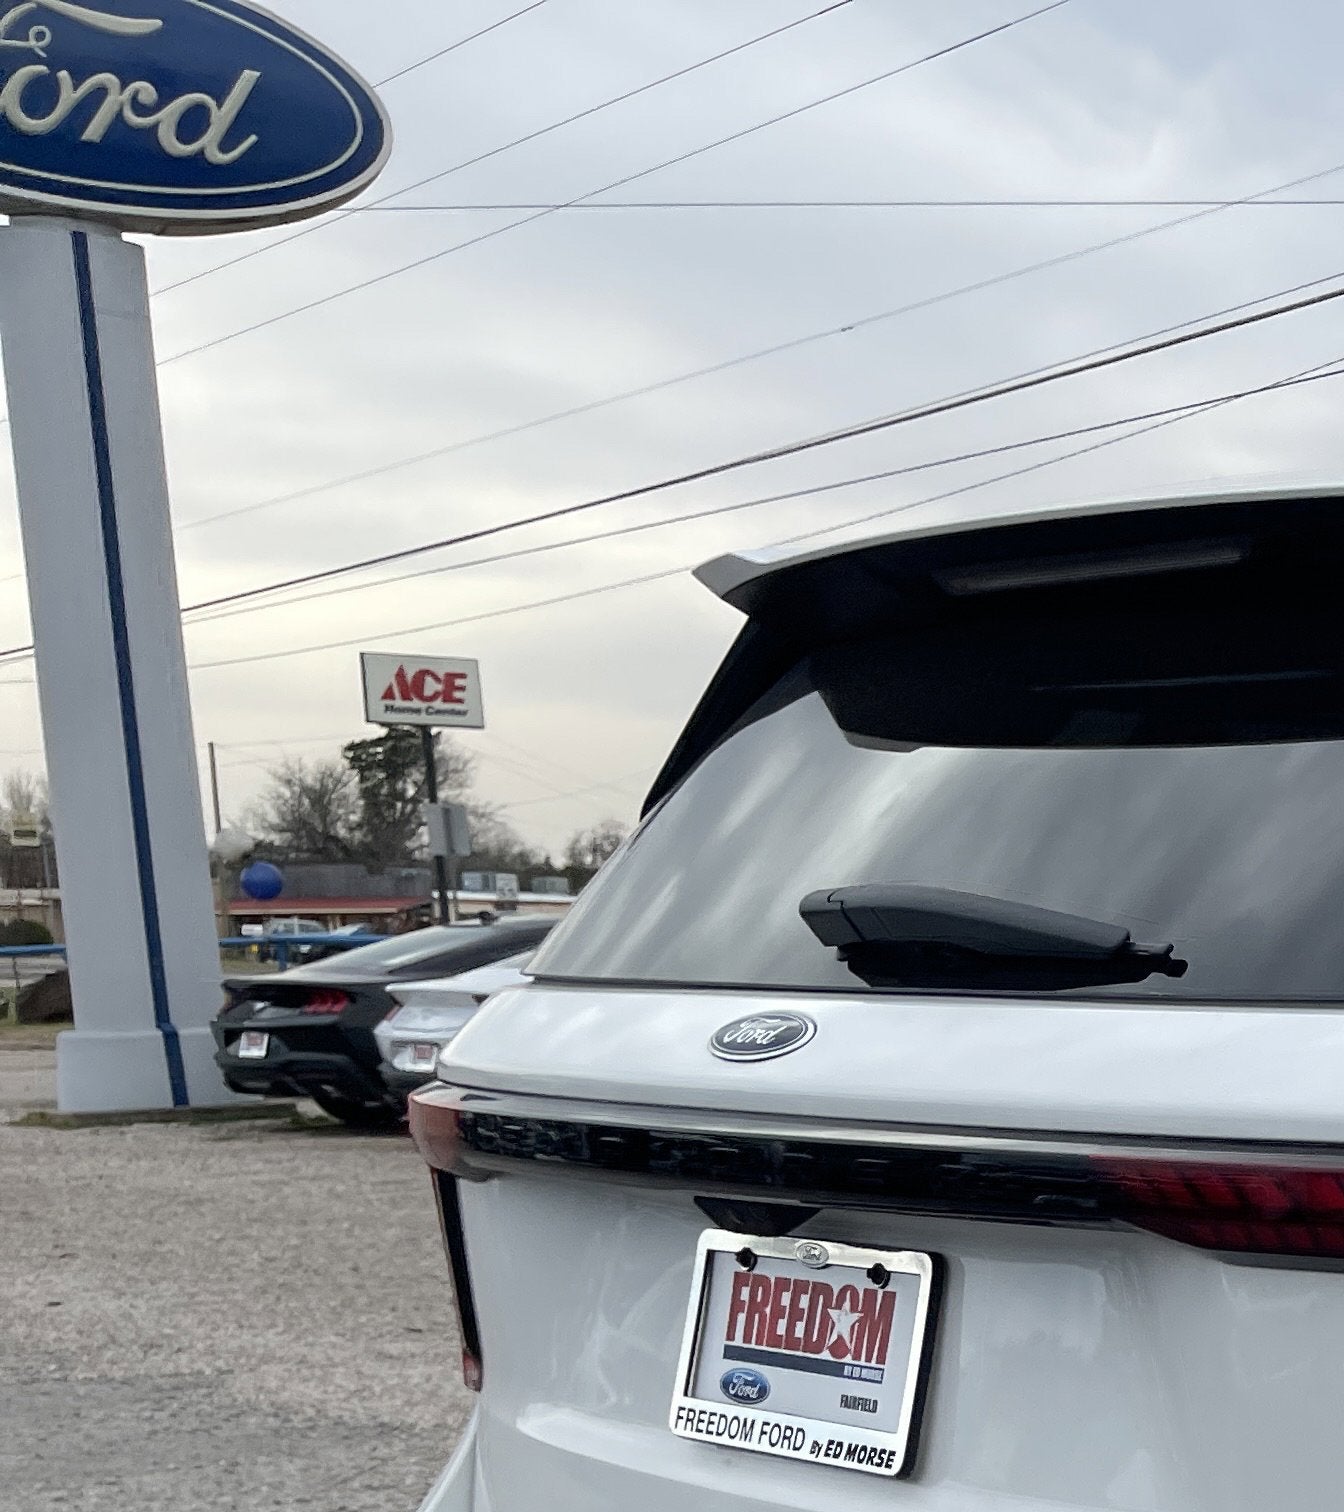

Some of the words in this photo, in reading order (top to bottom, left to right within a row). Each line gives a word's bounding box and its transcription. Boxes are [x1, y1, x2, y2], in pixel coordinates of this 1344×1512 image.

[381, 664, 468, 704] ACE
[723, 1017, 788, 1044] Ford
[725, 1271, 897, 1365] FREEDOM
[728, 1373, 761, 1399] Ford
[840, 1394, 878, 1413] FAIRFIELD
[674, 1406, 756, 1443] FREEDOM
[758, 1421, 806, 1451] FORD
[824, 1439, 844, 1459] ED
[844, 1443, 896, 1469] MORSE
